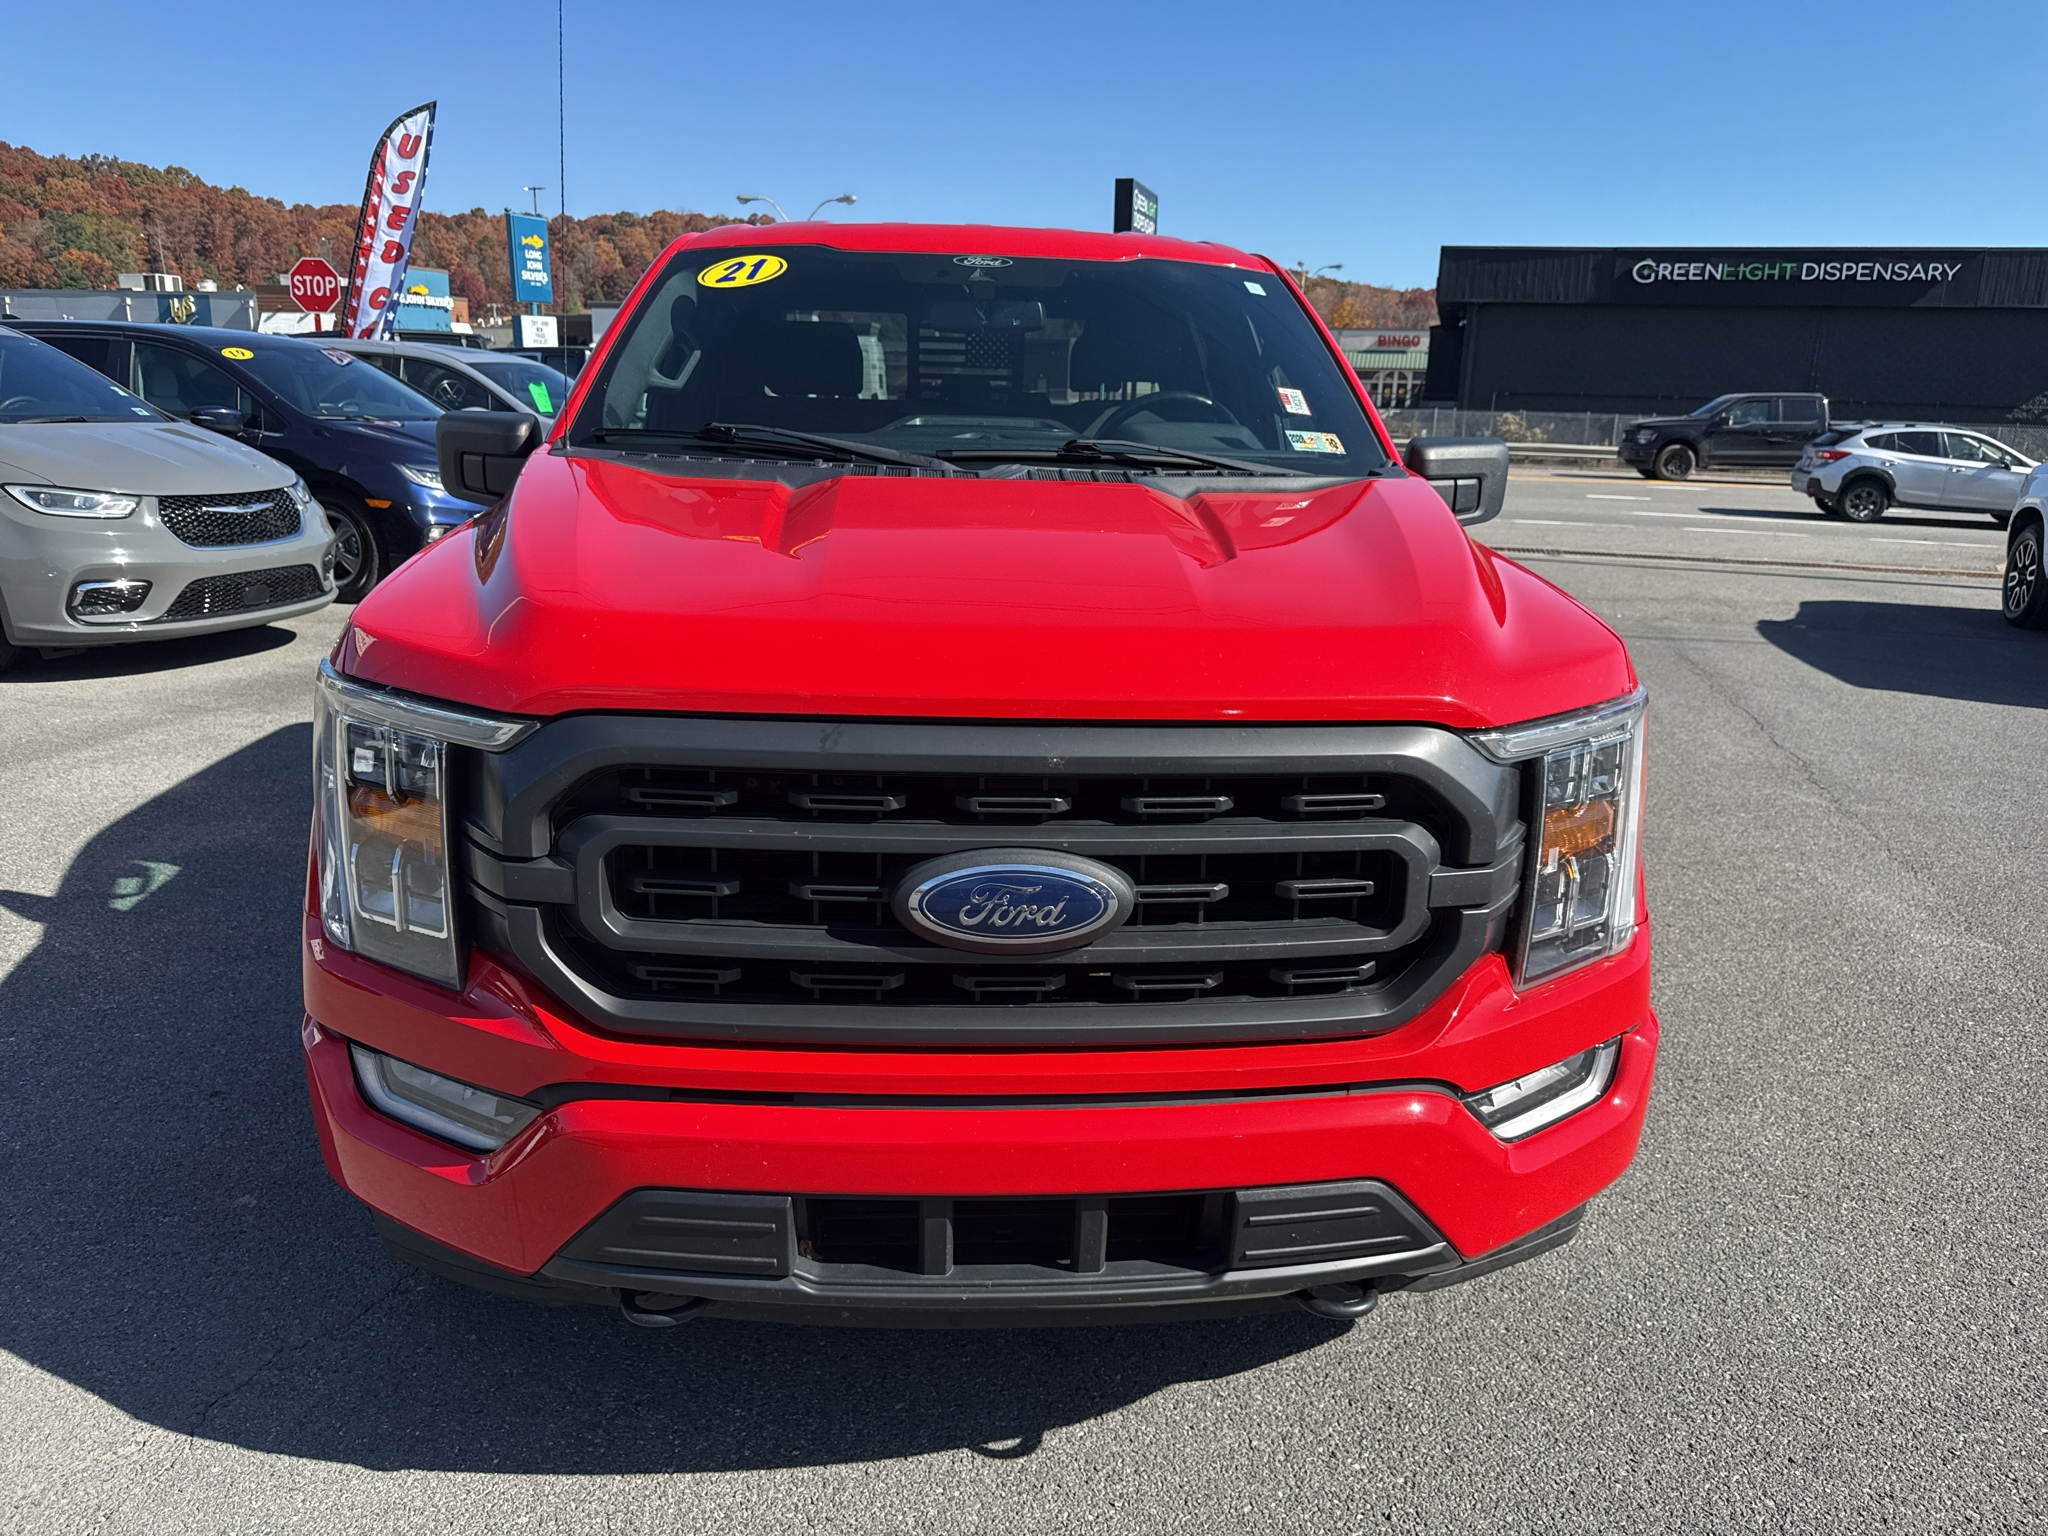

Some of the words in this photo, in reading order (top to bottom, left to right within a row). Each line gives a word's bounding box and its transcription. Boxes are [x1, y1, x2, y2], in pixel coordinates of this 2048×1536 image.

[380, 133, 423, 264] USED
[525, 249, 542, 260] LONG
[526, 260, 543, 270] JOHN
[963, 256, 1002, 266] Ford
[715, 258, 768, 283] 21
[1632, 258, 1797, 283] GREENLIGHT
[1800, 262, 1962, 281] DISPENSARY
[293, 275, 336, 297] STOP
[405, 294, 425, 305] JOHN
[1377, 335, 1420, 347] BINGO
[228, 350, 246, 358] 19
[958, 882, 1070, 927] Ford
